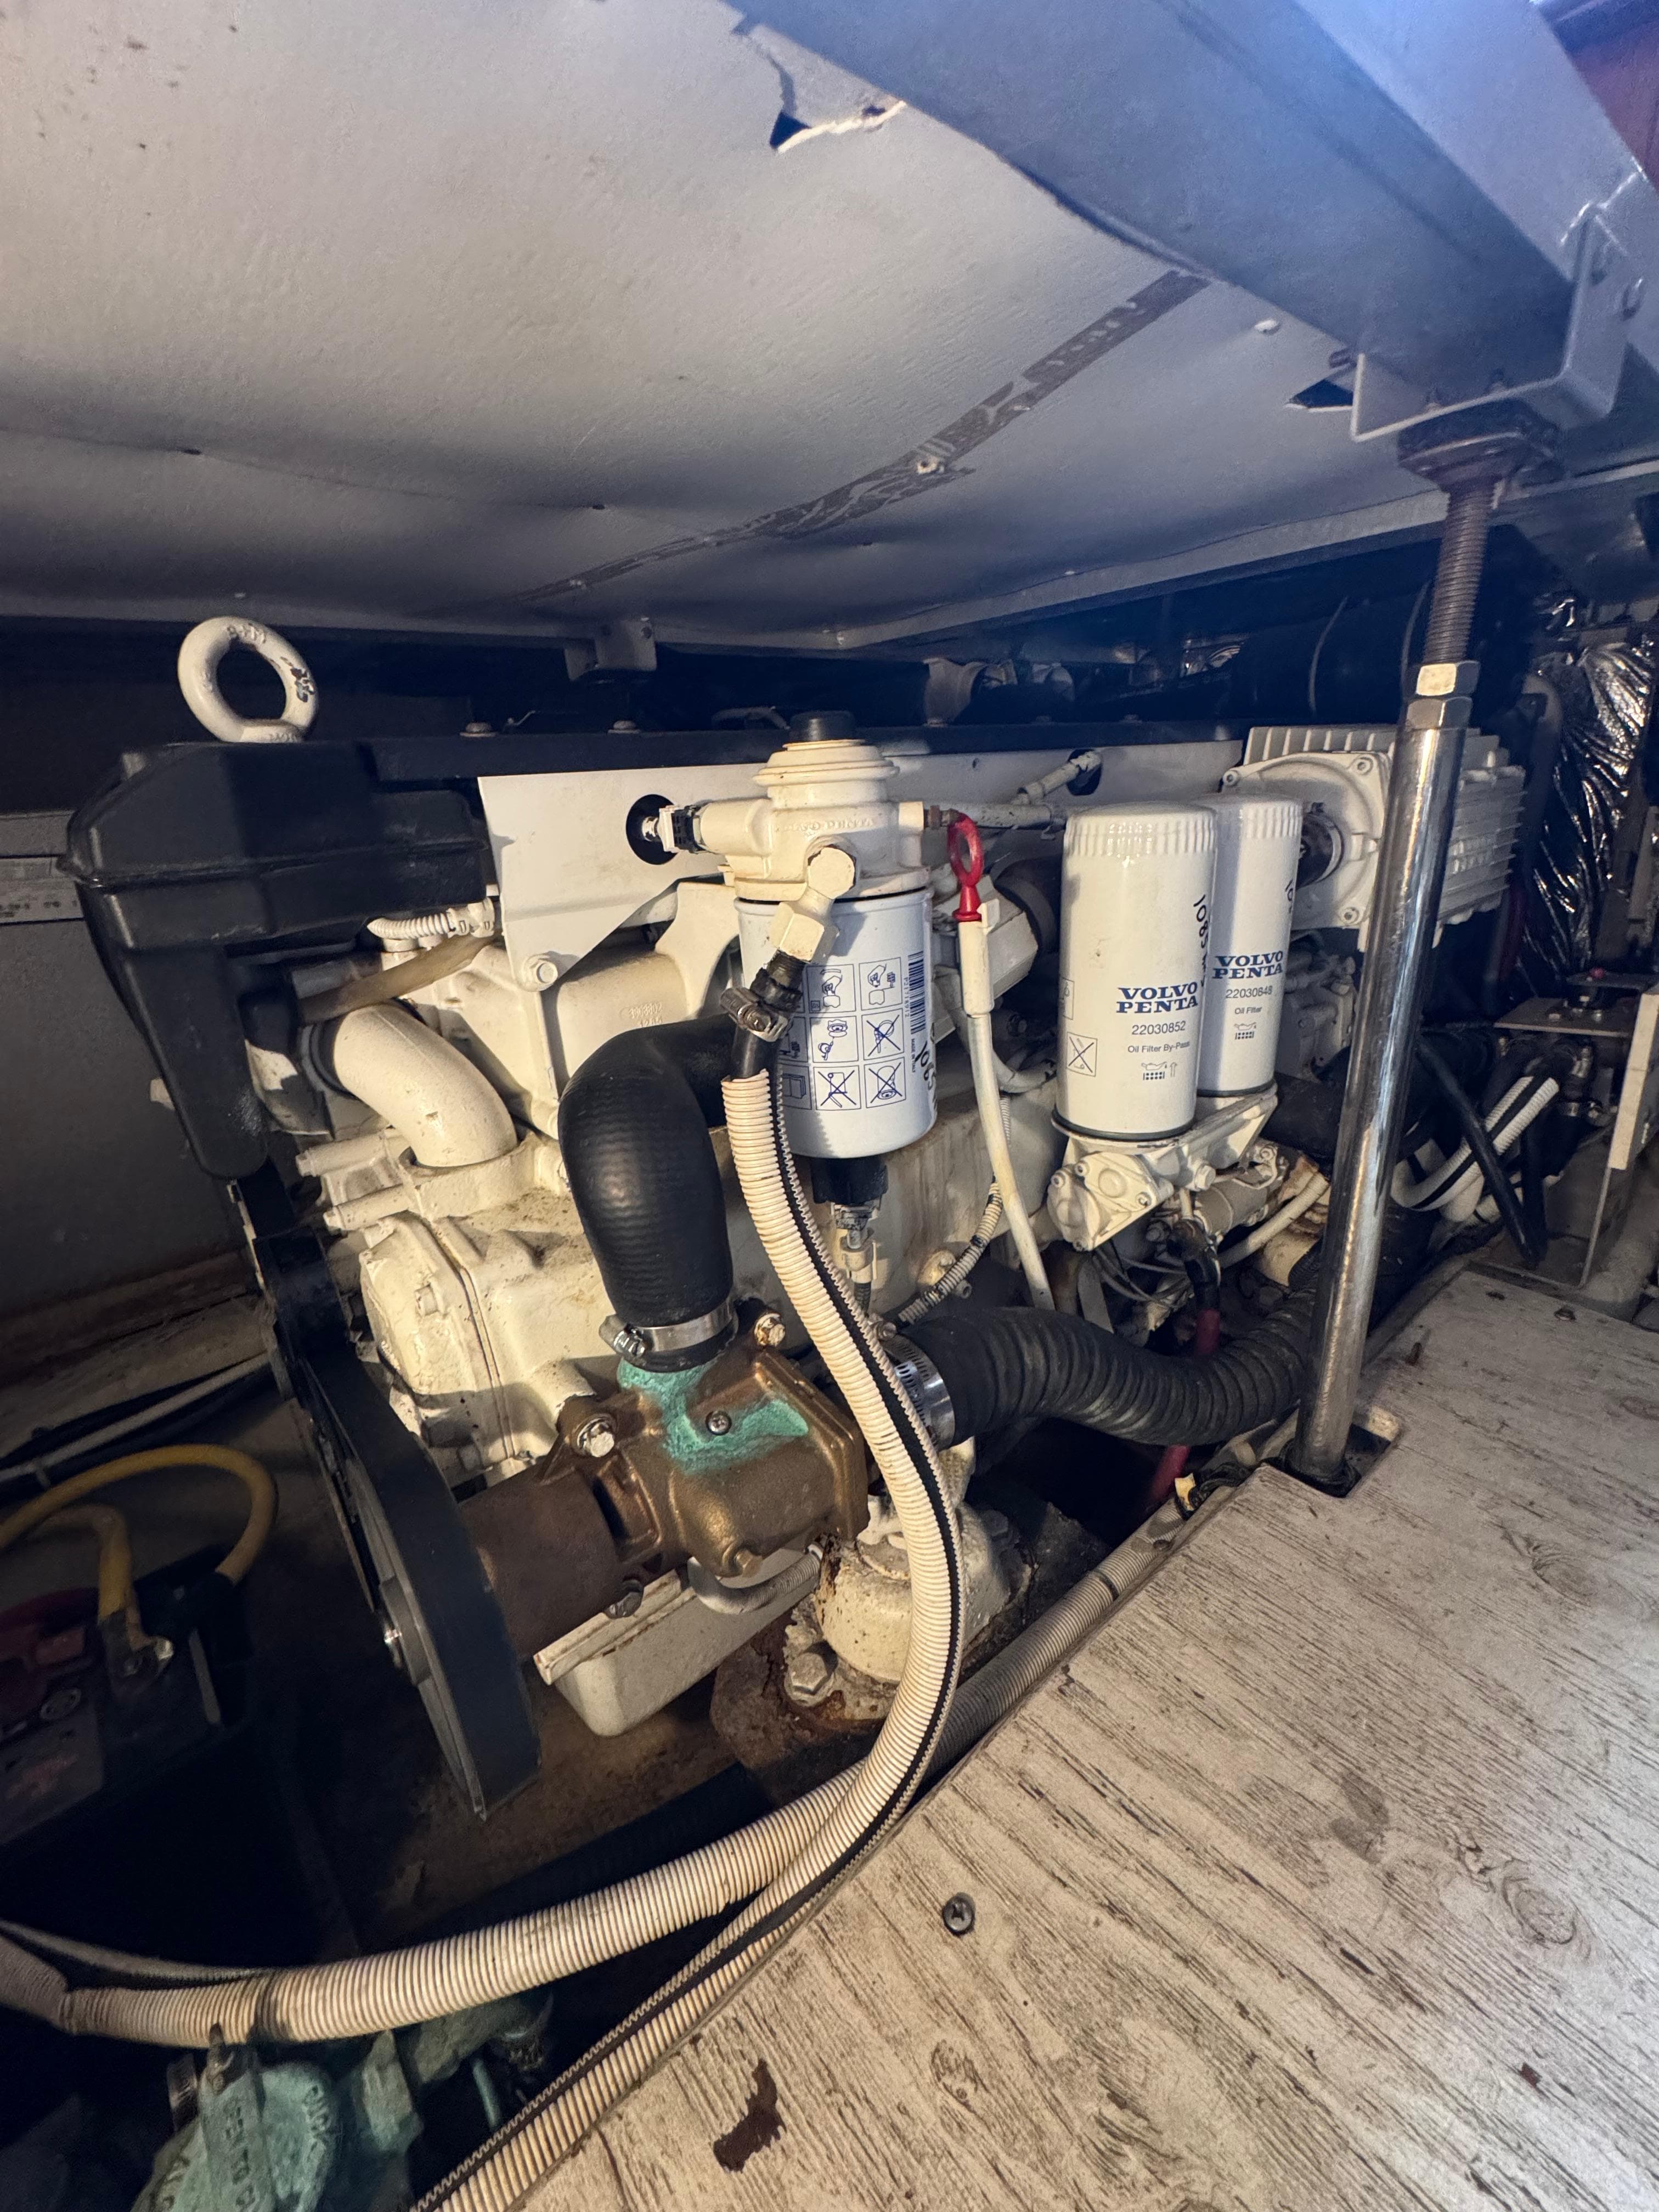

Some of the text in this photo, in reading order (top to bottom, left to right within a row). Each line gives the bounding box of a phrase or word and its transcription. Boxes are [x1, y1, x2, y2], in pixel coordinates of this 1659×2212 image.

[1215, 950, 1284, 968] VOLVO
[1212, 962, 1283, 979] PENTA
[1117, 981, 1198, 1000] VOLVO
[1115, 995, 1198, 1014] PENTA
[1246, 1006, 1262, 1014] Filter
[1131, 1020, 1187, 1035] 22030852
[1127, 1041, 1190, 1053] Oil Filter By-Pass
